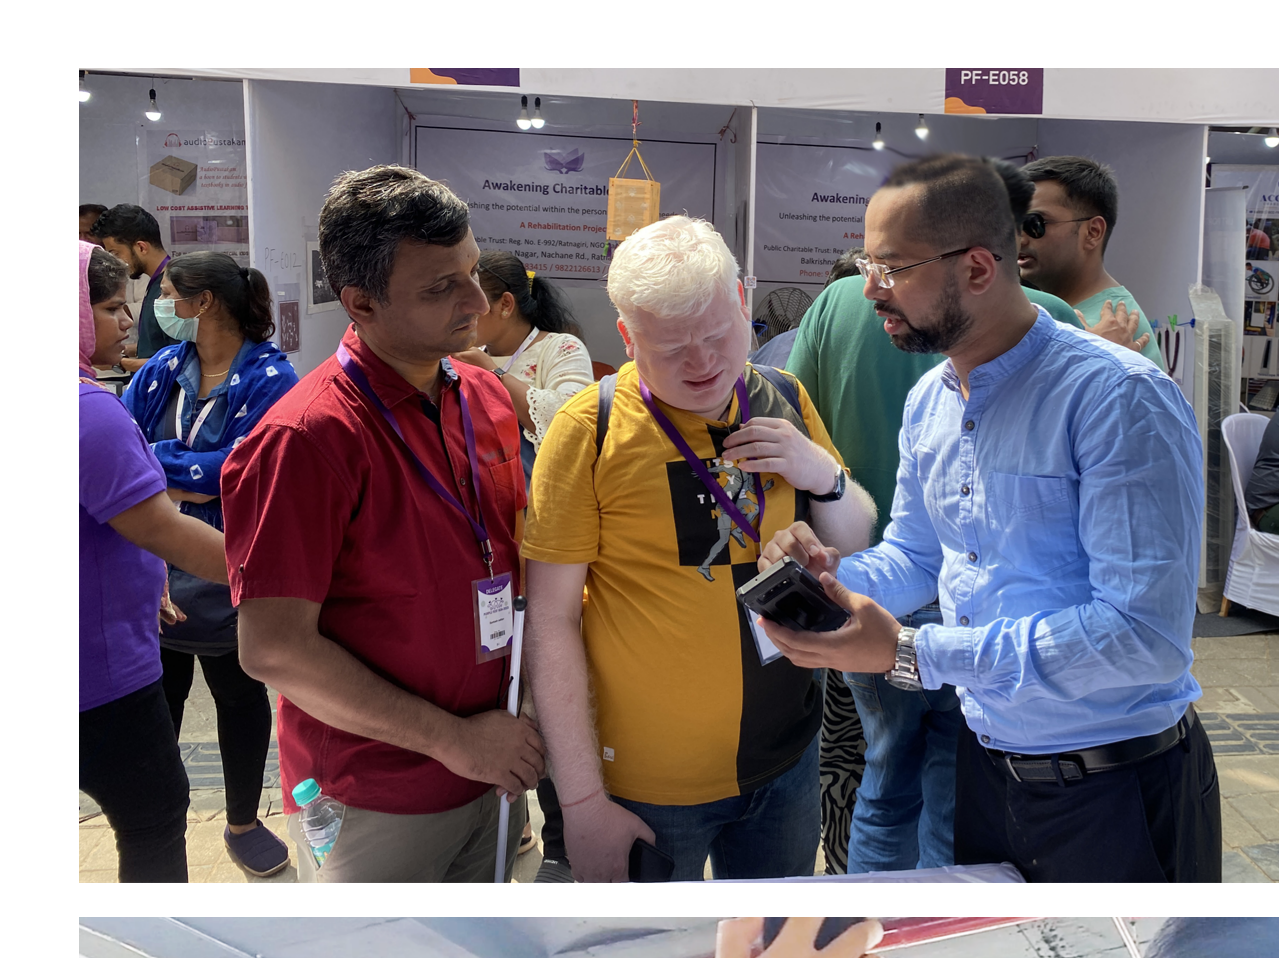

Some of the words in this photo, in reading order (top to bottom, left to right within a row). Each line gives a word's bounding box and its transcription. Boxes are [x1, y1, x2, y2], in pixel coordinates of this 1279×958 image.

[961, 70, 1029, 86] PF-E058
[482, 179, 549, 195] Awakening
[492, 202, 504, 210] the
[506, 204, 540, 212] potential
[542, 205, 566, 213] within
[567, 207, 580, 215] the
[581, 208, 607, 216] person
[779, 212, 818, 223] Unleashing
[832, 215, 863, 223] potential
[527, 222, 581, 232] Rehabilitation
[509, 238, 521, 247] Reg.
[763, 244, 781, 252] Public
[783, 245, 813, 253] Charitable
[514, 250, 539, 259] Nagar,
[541, 251, 574, 260] Nachane
